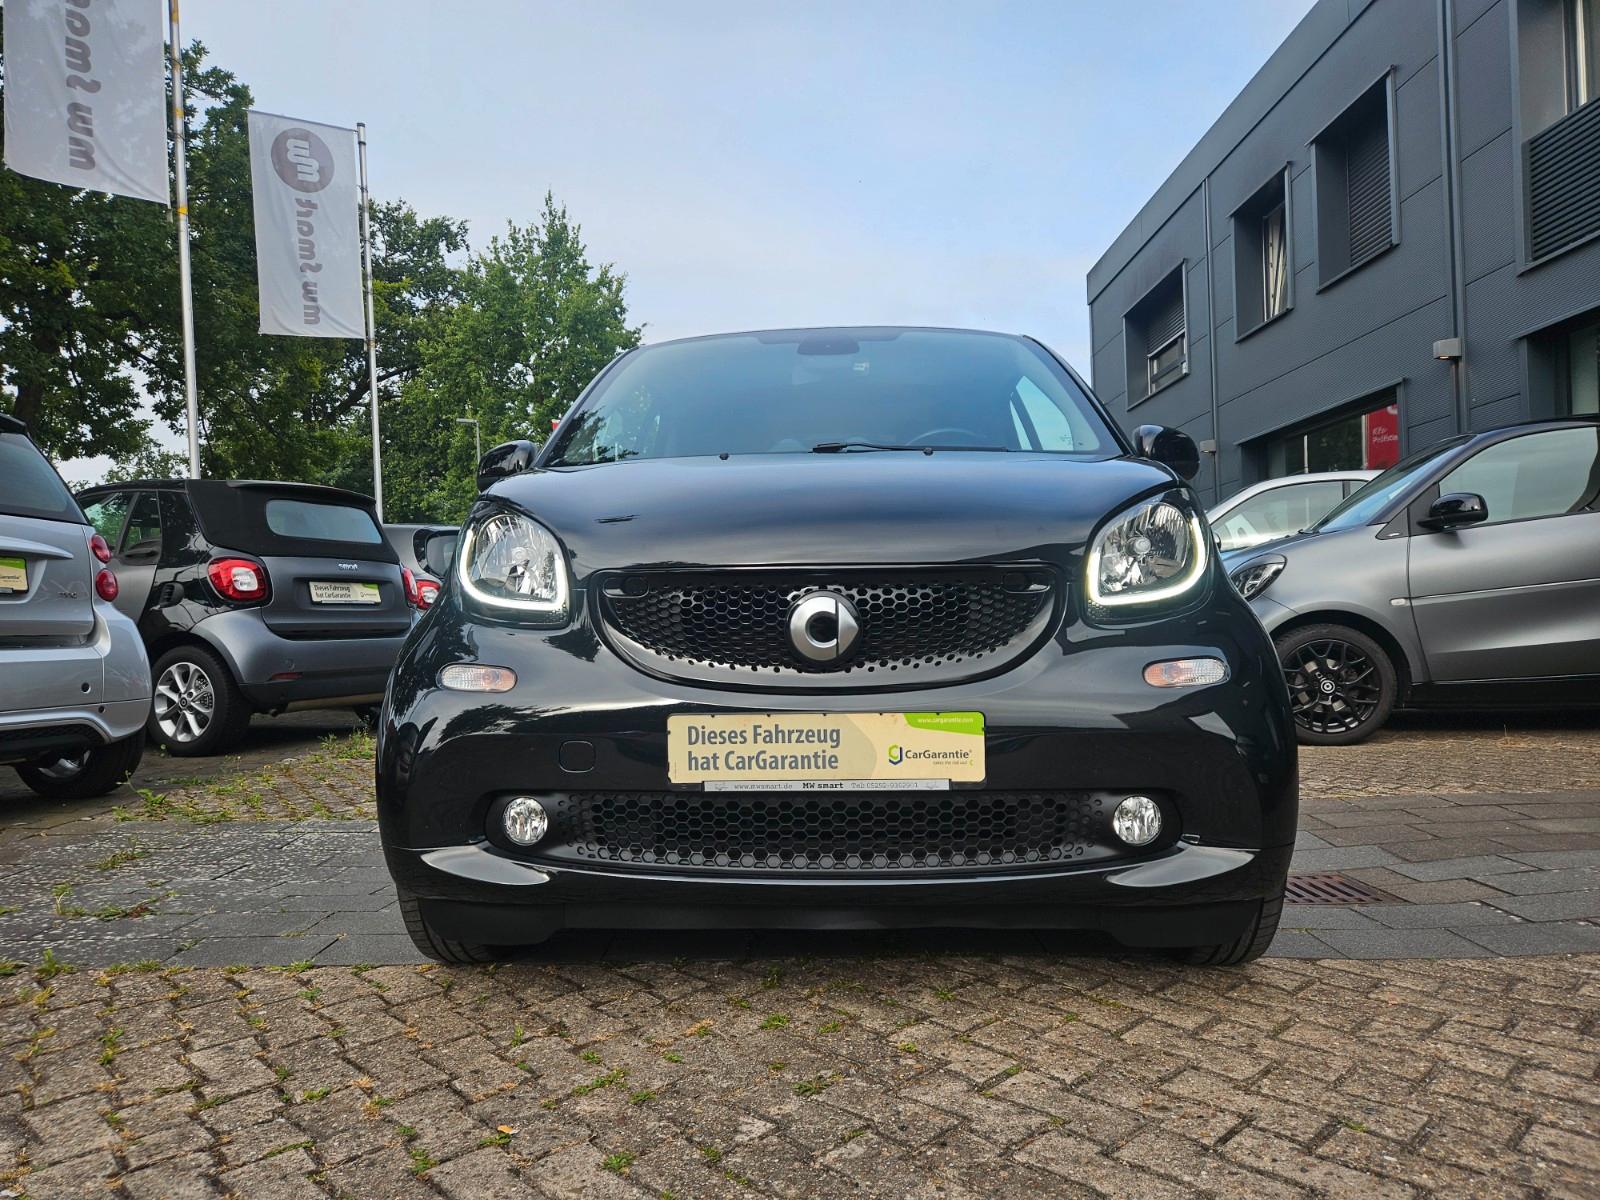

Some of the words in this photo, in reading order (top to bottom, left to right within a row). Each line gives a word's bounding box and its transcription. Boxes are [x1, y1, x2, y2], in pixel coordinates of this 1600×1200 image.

[687, 725, 747, 745] Dieses
[752, 724, 841, 748] Fahrzeug
[687, 750, 720, 771] hat
[724, 750, 839, 771] CarGarantie
[905, 749, 969, 759] CarGarantie
